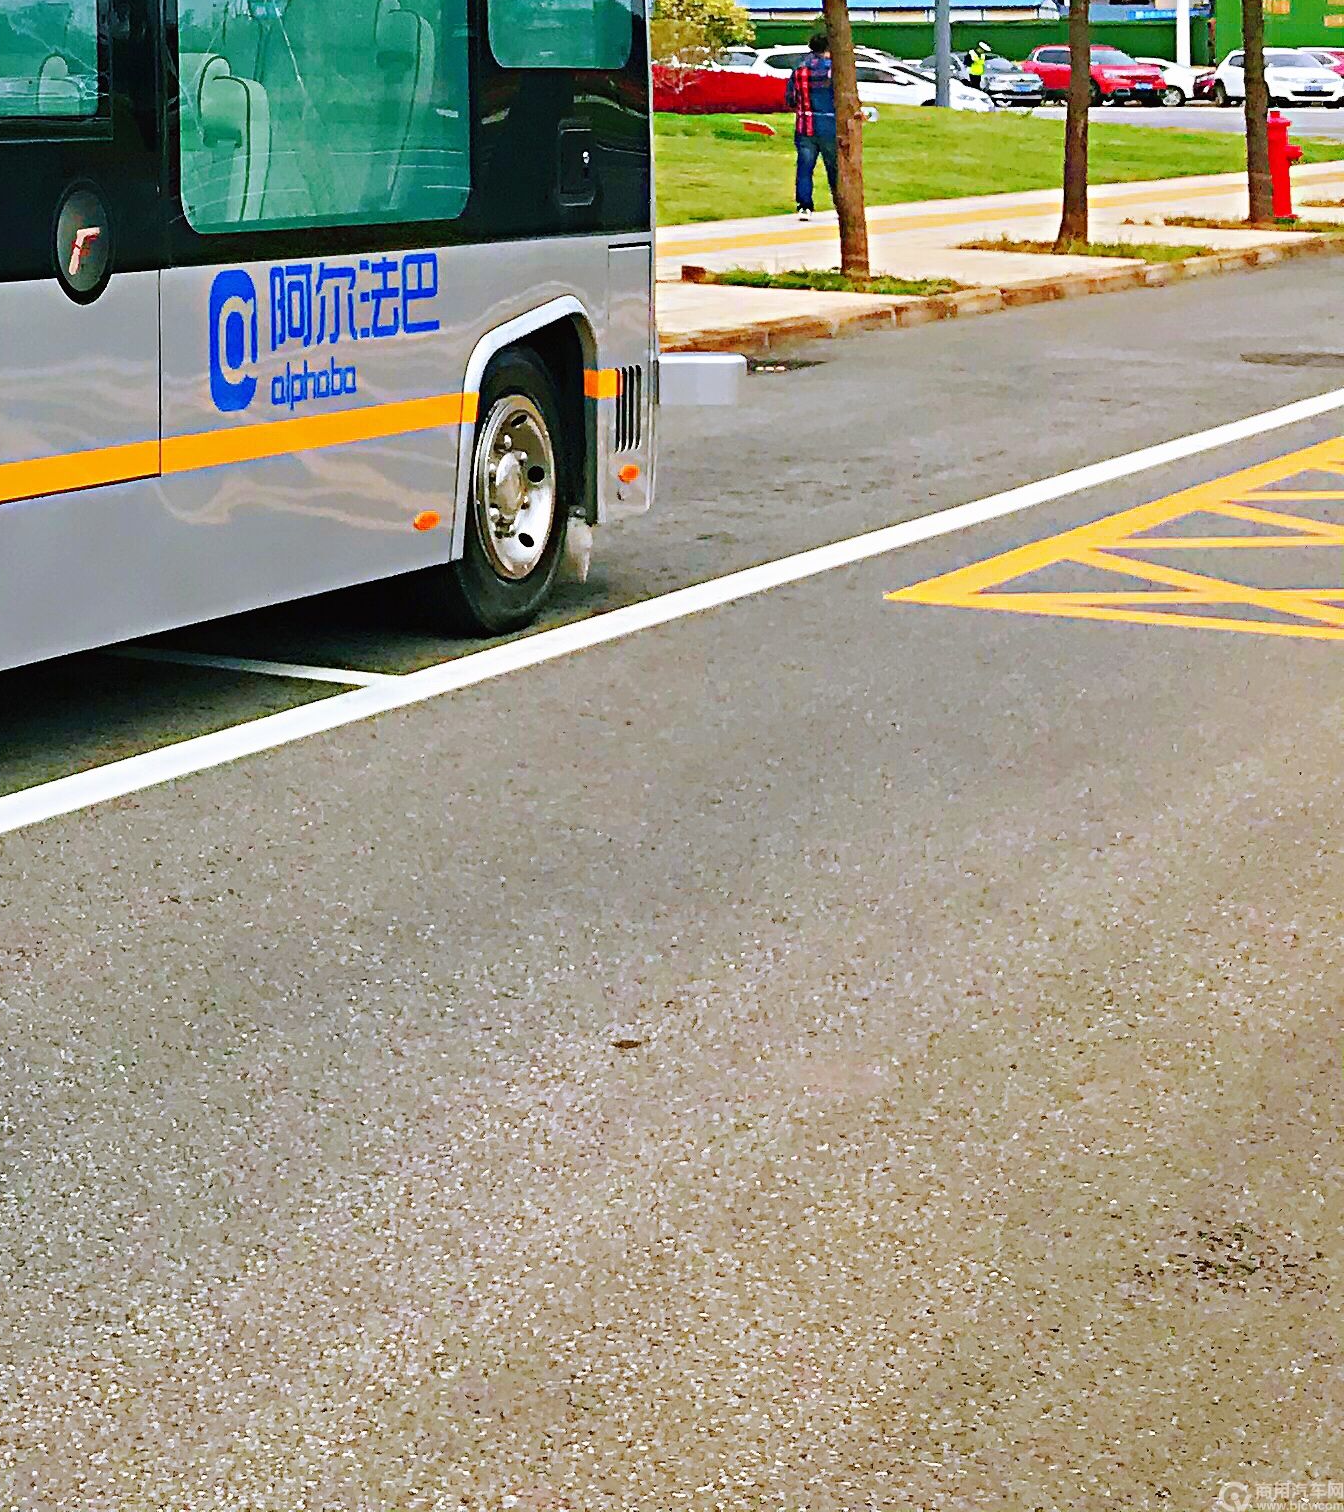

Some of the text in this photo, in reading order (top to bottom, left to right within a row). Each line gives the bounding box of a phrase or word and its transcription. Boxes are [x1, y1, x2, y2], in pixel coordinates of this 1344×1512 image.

[268, 252, 440, 352] 阿尔法巴
[270, 355, 357, 411] alphaba
